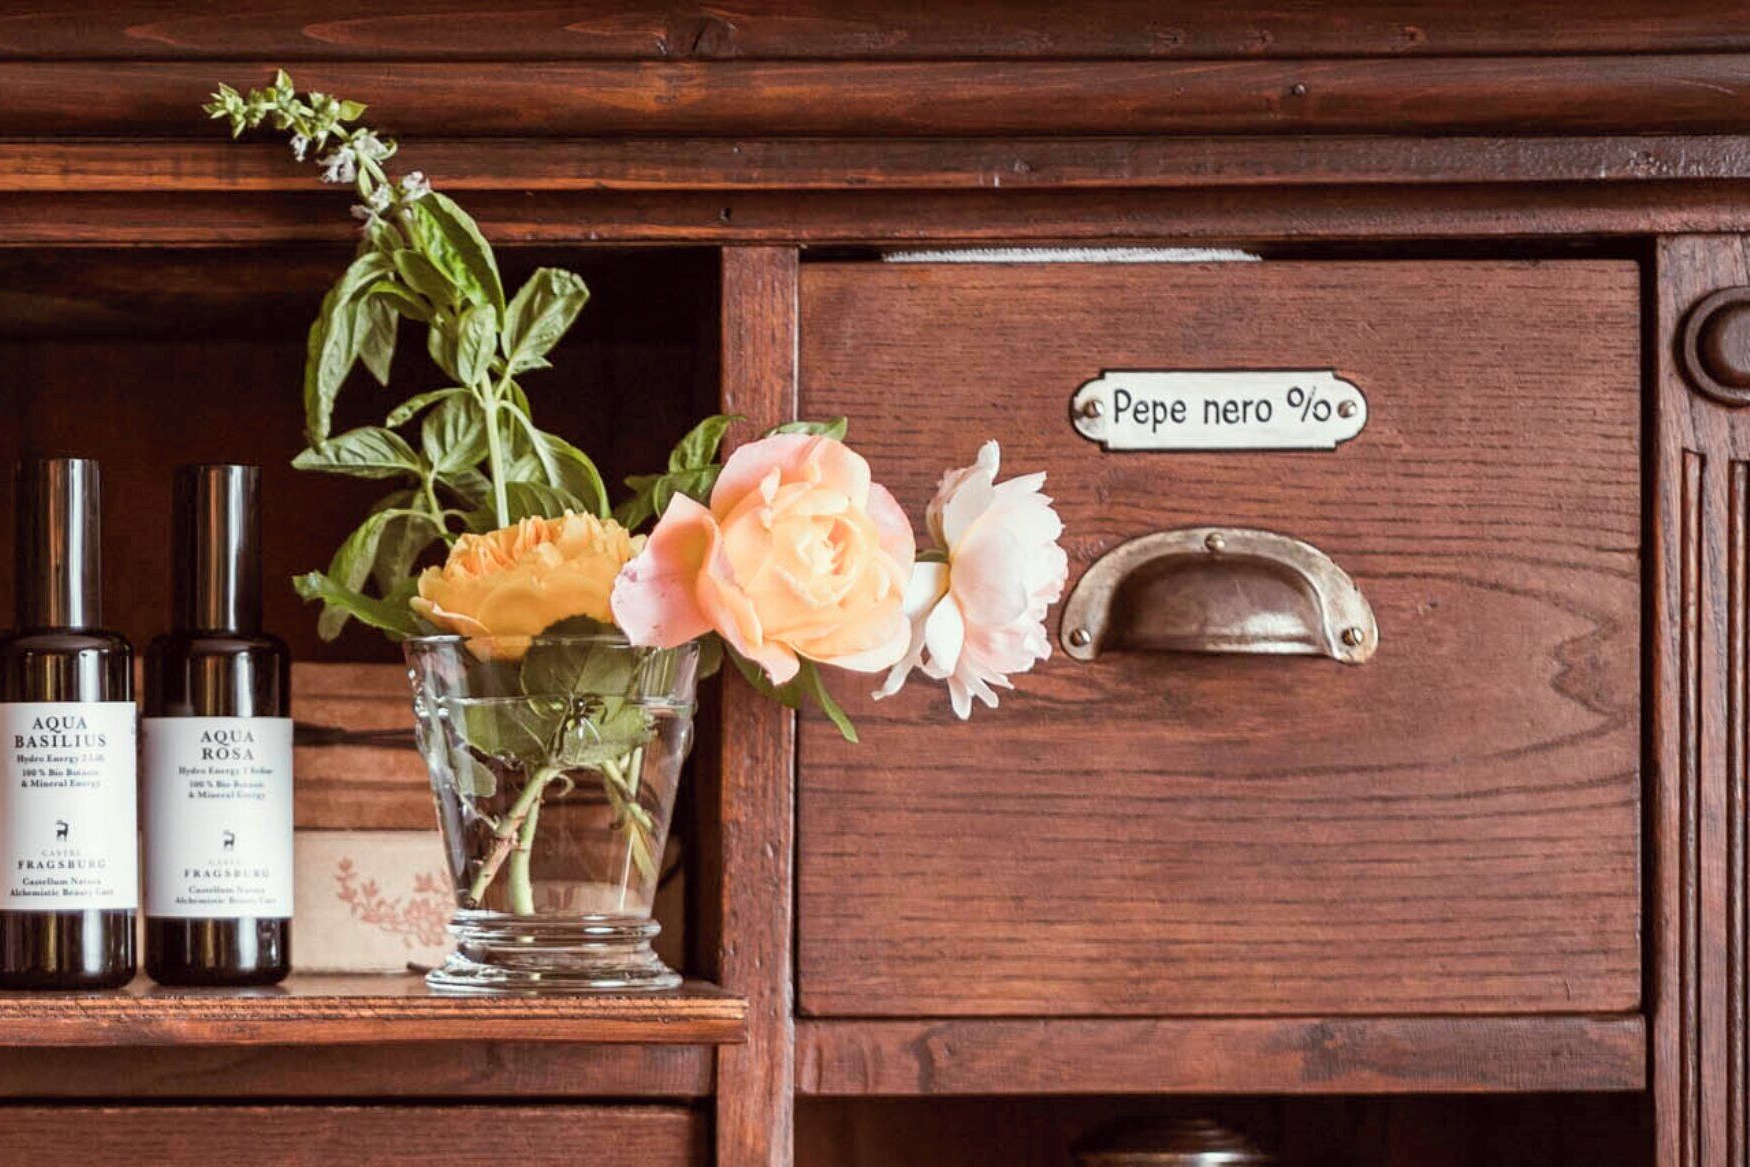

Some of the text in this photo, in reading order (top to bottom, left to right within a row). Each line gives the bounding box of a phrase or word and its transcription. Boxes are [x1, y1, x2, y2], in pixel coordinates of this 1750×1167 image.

[1113, 388, 1187, 433] Pepe
[1203, 399, 1273, 424] nero
[32, 716, 87, 733] AQUA
[14, 734, 106, 748] BASILIUS
[200, 730, 255, 745] AQUA
[16, 754, 44, 764] Hydro
[47, 754, 79, 764] Energy
[202, 748, 254, 760] ROSA
[30, 779, 67, 788] Mineral
[17, 859, 106, 870] FRAGSBURG
